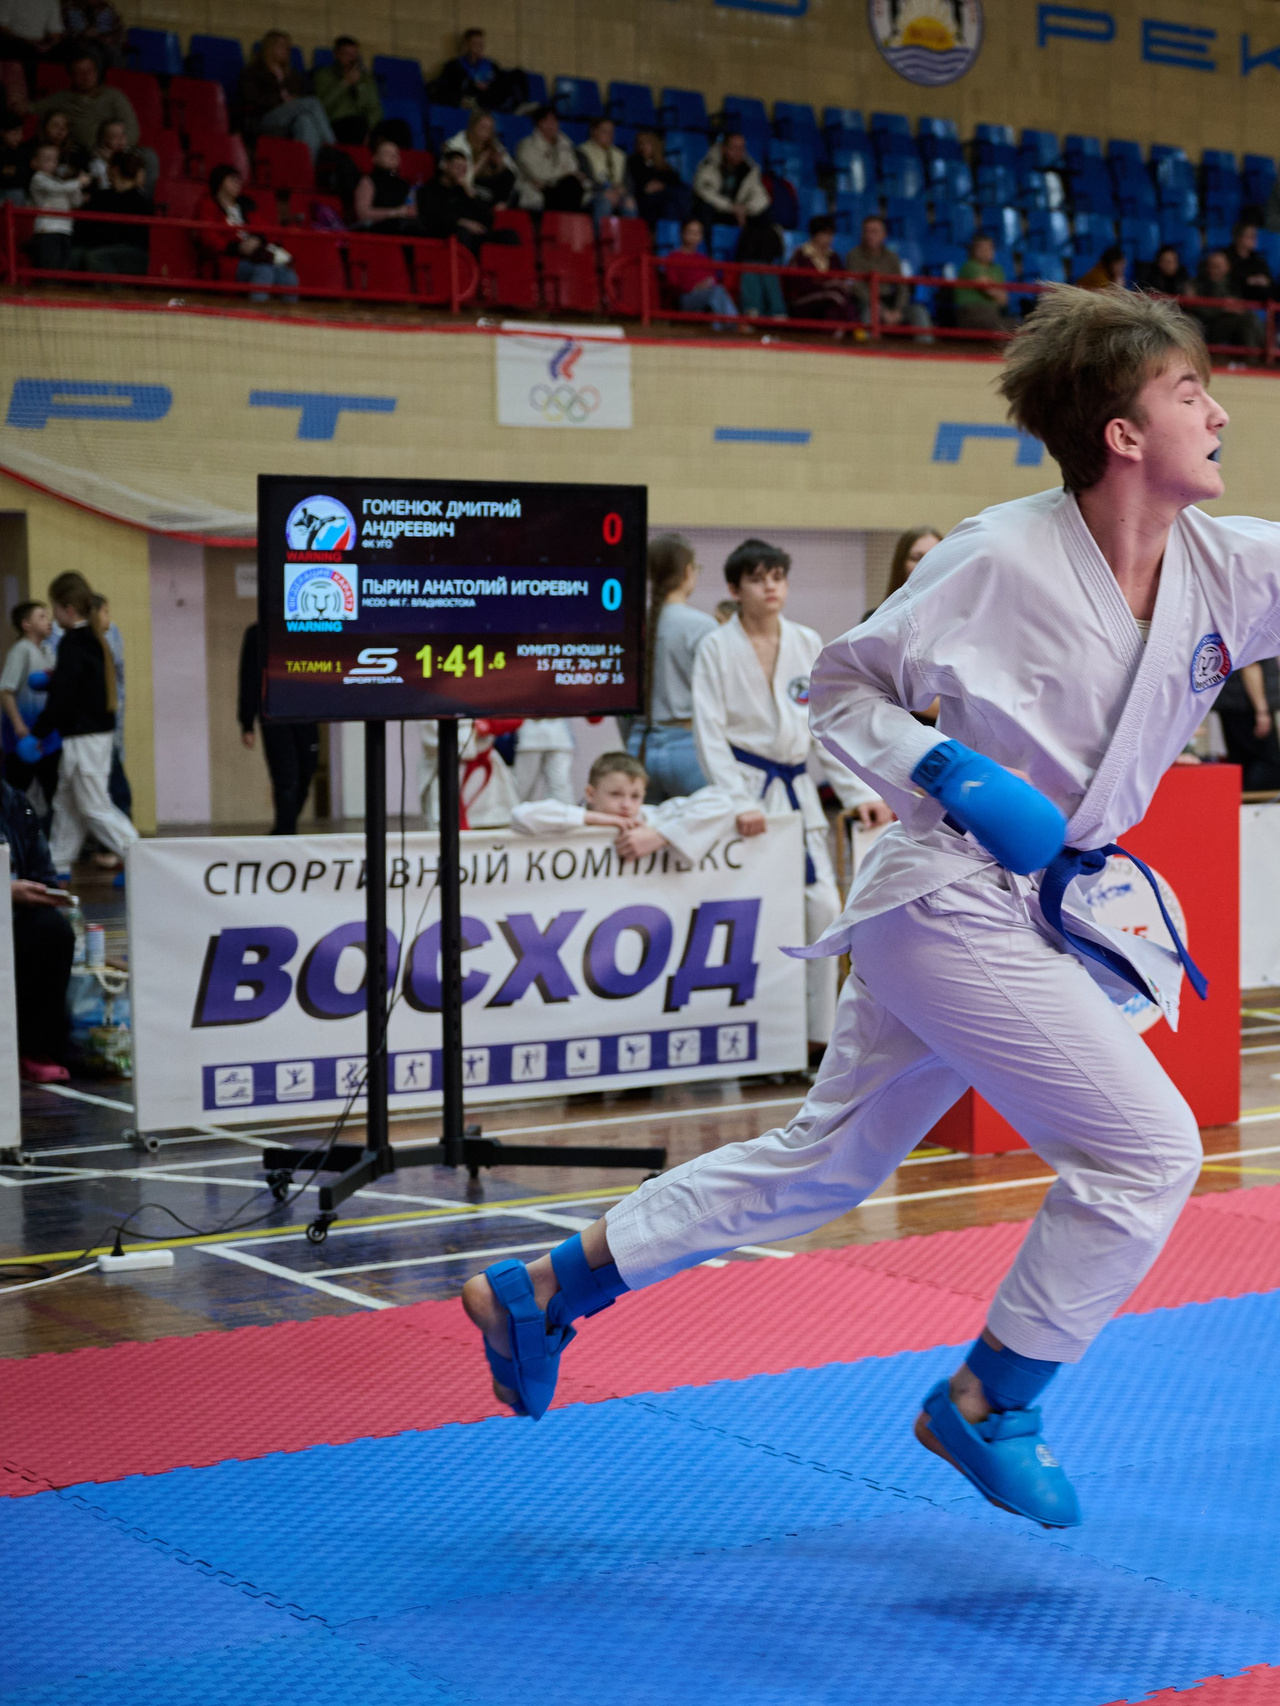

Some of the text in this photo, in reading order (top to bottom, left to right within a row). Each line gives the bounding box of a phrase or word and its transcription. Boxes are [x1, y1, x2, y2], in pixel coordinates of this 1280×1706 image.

[362, 498, 521, 519] ГОМЕНЮК ДМИТРИЙ
[361, 520, 455, 539] АНДРЕЕВИЧ
[602, 511, 623, 546] 0
[286, 551, 343, 562] WARNING
[362, 576, 589, 596] ПЫРИН АНАТОЛИЙ ИГОРЕВИЧ
[601, 578, 623, 611] 0
[286, 620, 343, 633] WARNING
[285, 660, 342, 674] ТАТАМИ 1
[536, 658, 550, 671] 15
[342, 675, 405, 685] SPORTDATA
[555, 672, 594, 685] ROUND
[594, 673, 610, 684] OF
[191, 898, 763, 1029] ВОСХОД
